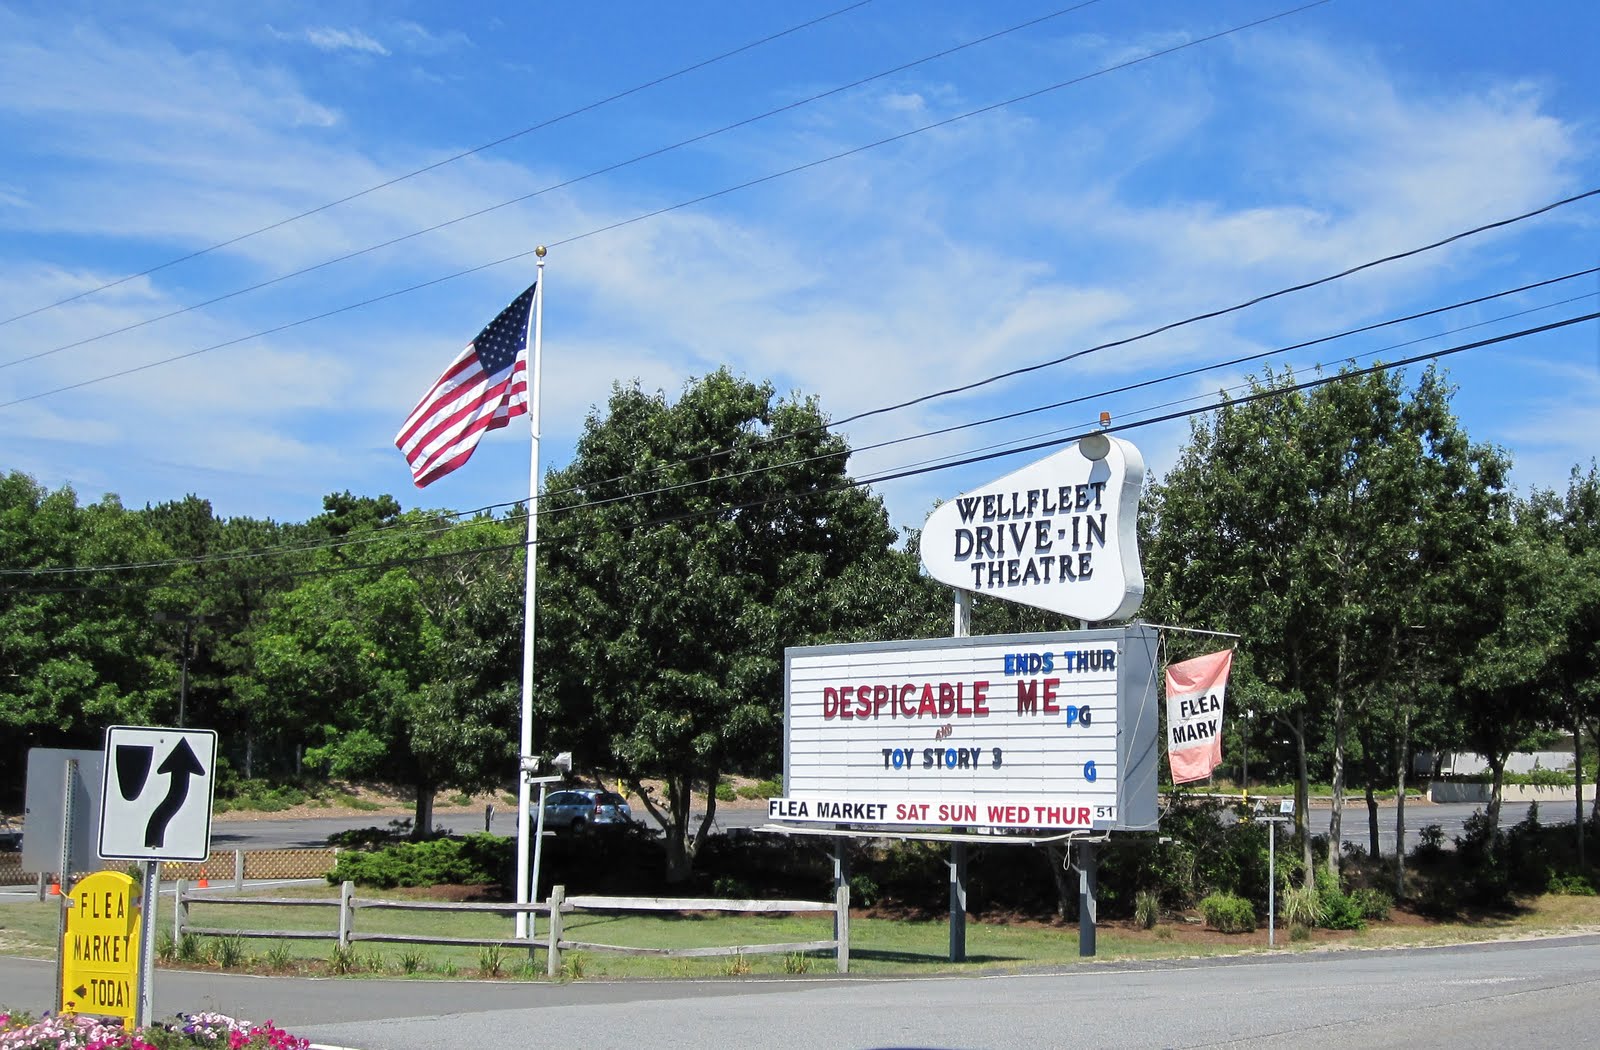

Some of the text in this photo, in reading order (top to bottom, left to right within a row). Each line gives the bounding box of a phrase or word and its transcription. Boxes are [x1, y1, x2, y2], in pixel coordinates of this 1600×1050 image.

[956, 481, 1107, 524] WELLFLEET
[954, 513, 1107, 560] DRIVE-IN
[971, 552, 1093, 588] THEATRE
[1004, 649, 1116, 676] ENDS THUR
[823, 678, 1061, 719] DESPICABLE ME
[1180, 694, 1220, 718] FLEA
[1066, 705, 1091, 728] PG
[935, 723, 953, 742] AND
[882, 747, 1003, 770] TOY STORY 3
[1083, 760, 1097, 783] G
[769, 800, 1091, 825] FLEA MARKET SAT SUN WED THUR
[1096, 807, 1113, 818] 51
[81, 892, 124, 918] FLEA
[74, 935, 130, 962] MARKET
